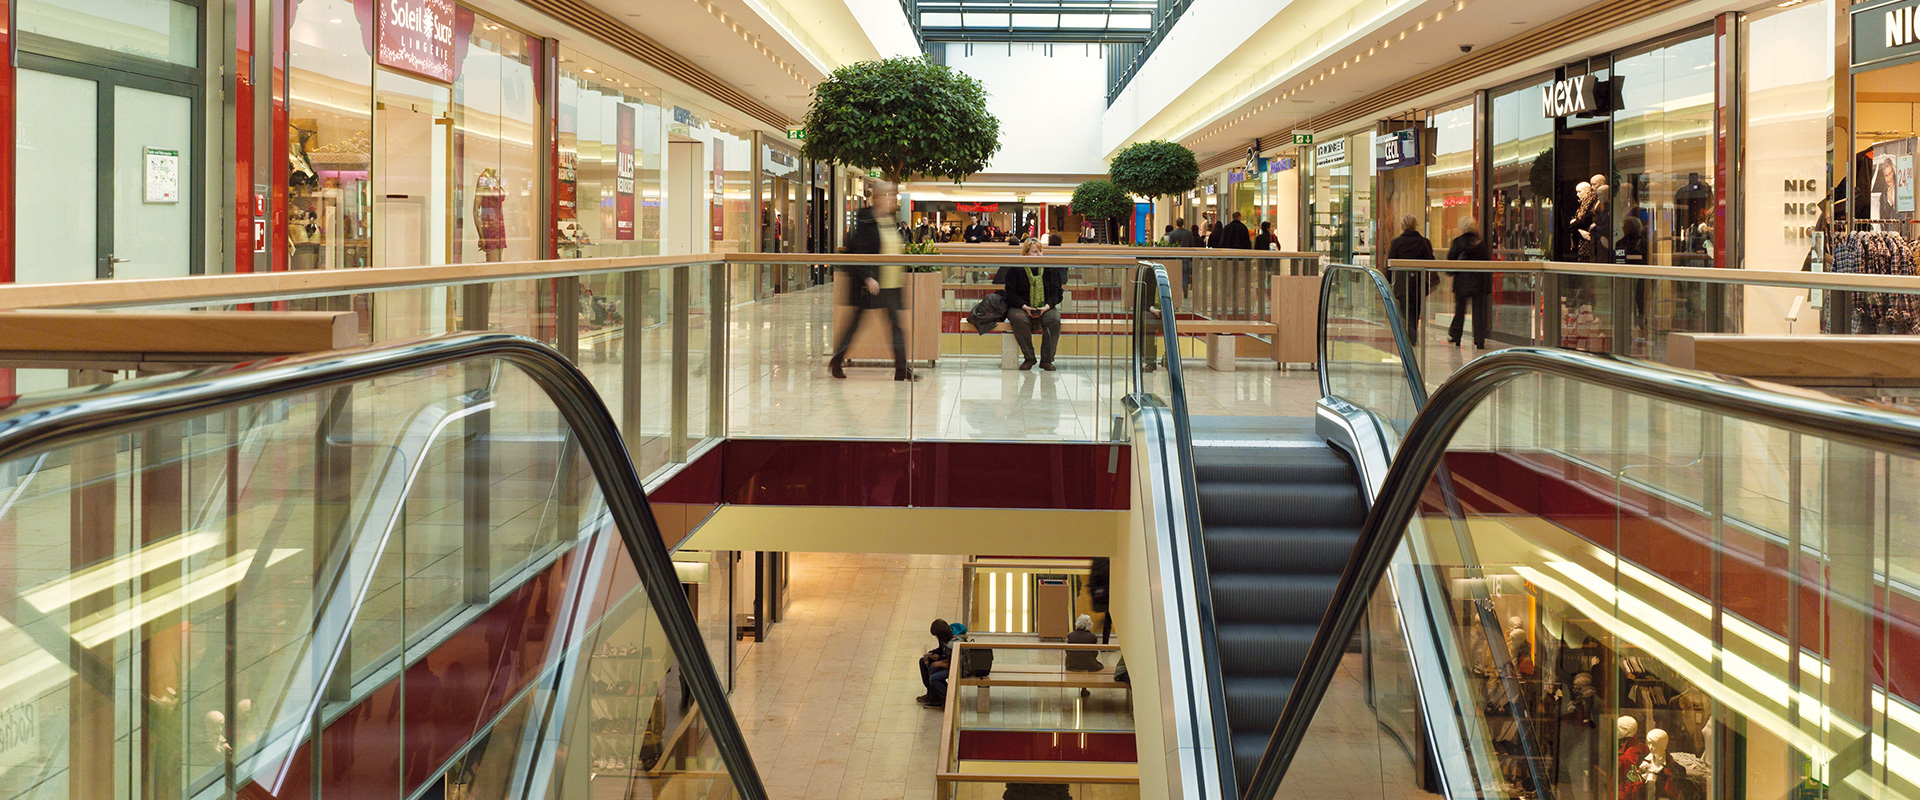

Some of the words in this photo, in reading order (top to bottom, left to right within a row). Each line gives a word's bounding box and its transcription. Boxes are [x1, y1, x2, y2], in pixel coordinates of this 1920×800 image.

[391, 0, 422, 33] Soleil
[434, 15, 452, 46] Sucré
[401, 35, 448, 60] LINGERIE
[618, 151, 634, 178] ALLES
[1784, 179, 1817, 192] NIC
[1784, 202, 1817, 215] NIC
